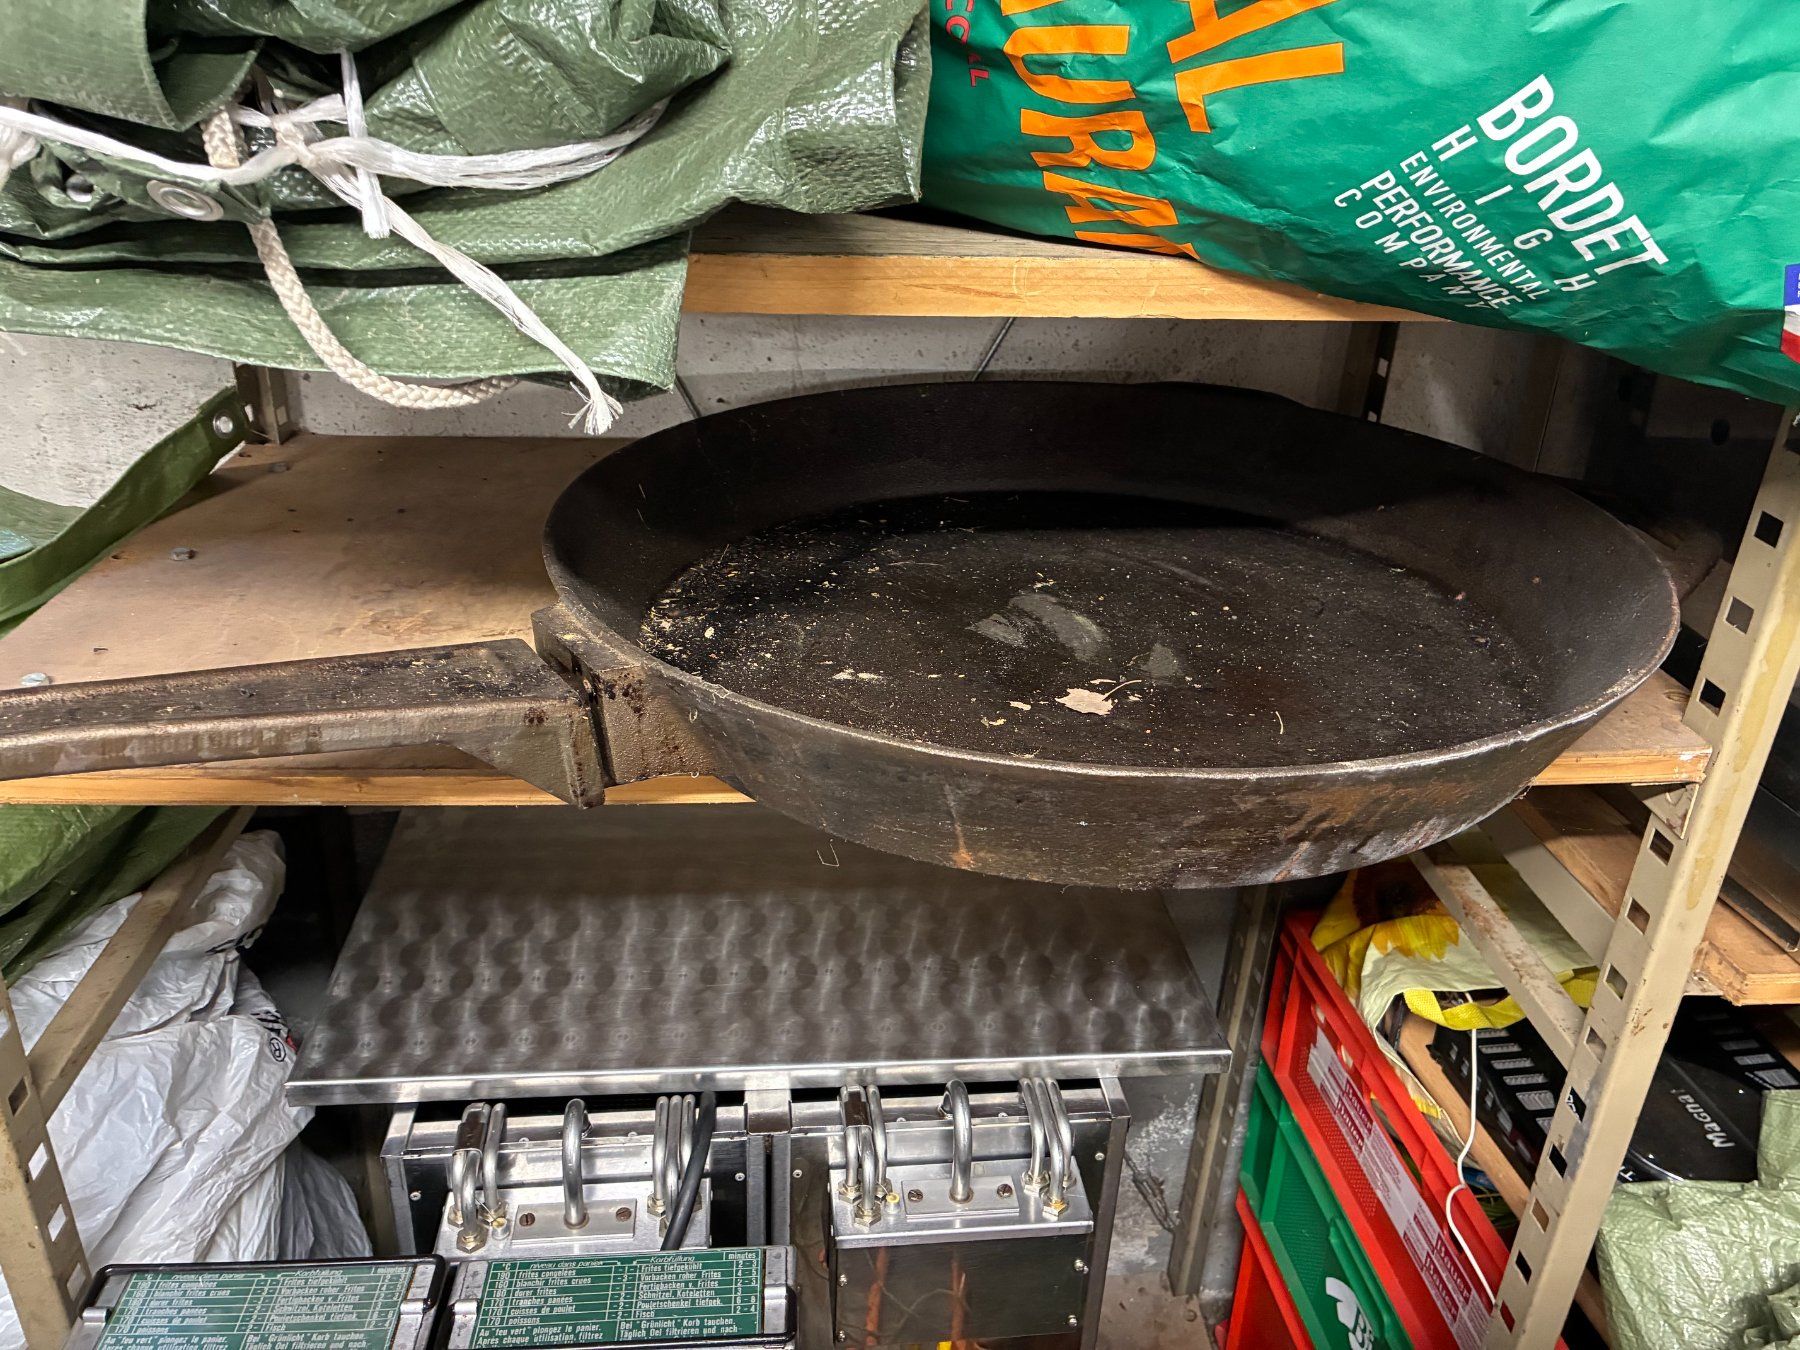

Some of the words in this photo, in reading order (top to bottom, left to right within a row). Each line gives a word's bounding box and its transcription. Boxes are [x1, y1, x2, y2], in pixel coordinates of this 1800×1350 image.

[1477, 73, 1669, 276] BORDET
[1431, 124, 1598, 293] HIGH
[1399, 150, 1550, 301] ENVIRONMENTAL
[1360, 170, 1523, 309] PERFORMANCE
[1334, 188, 1491, 309] COMPANY
[728, 1252, 757, 1260] minutes
[495, 1281, 509, 1289] 160
[516, 1279, 546, 1288] blanchir
[547, 1278, 568, 1287] frites
[641, 1273, 677, 1282] Vorbacken
[701, 1270, 722, 1279] Frites
[518, 1270, 539, 1279] frites
[642, 1265, 662, 1273] Frites
[514, 1288, 533, 1297] dorer
[537, 1287, 557, 1296] frites
[697, 1279, 719, 1288] Frites
[490, 1299, 506, 1307] 170
[512, 1297, 544, 1306] tranches
[488, 1308, 503, 1316] 170
[541, 1306, 552, 1314] de
[553, 1304, 576, 1315] poulet
[486, 1317, 501, 1326] 170
[509, 1316, 540, 1326] poissons
[635, 1310, 656, 1319] Fisch
[620, 1321, 633, 1330] Bei
[682, 1318, 700, 1327] Korb
[704, 1316, 736, 1326] tauchen.
[479, 1329, 490, 1337] Au
[532, 1325, 562, 1336] plongez
[565, 1324, 575, 1333] le
[575, 1323, 602, 1334] panier.
[502, 1335, 530, 1345] chaque
[578, 1330, 604, 1340] filtrez
[650, 1328, 662, 1337] Oel
[665, 1326, 700, 1336] filtrieren
[703, 1325, 717, 1334] und
